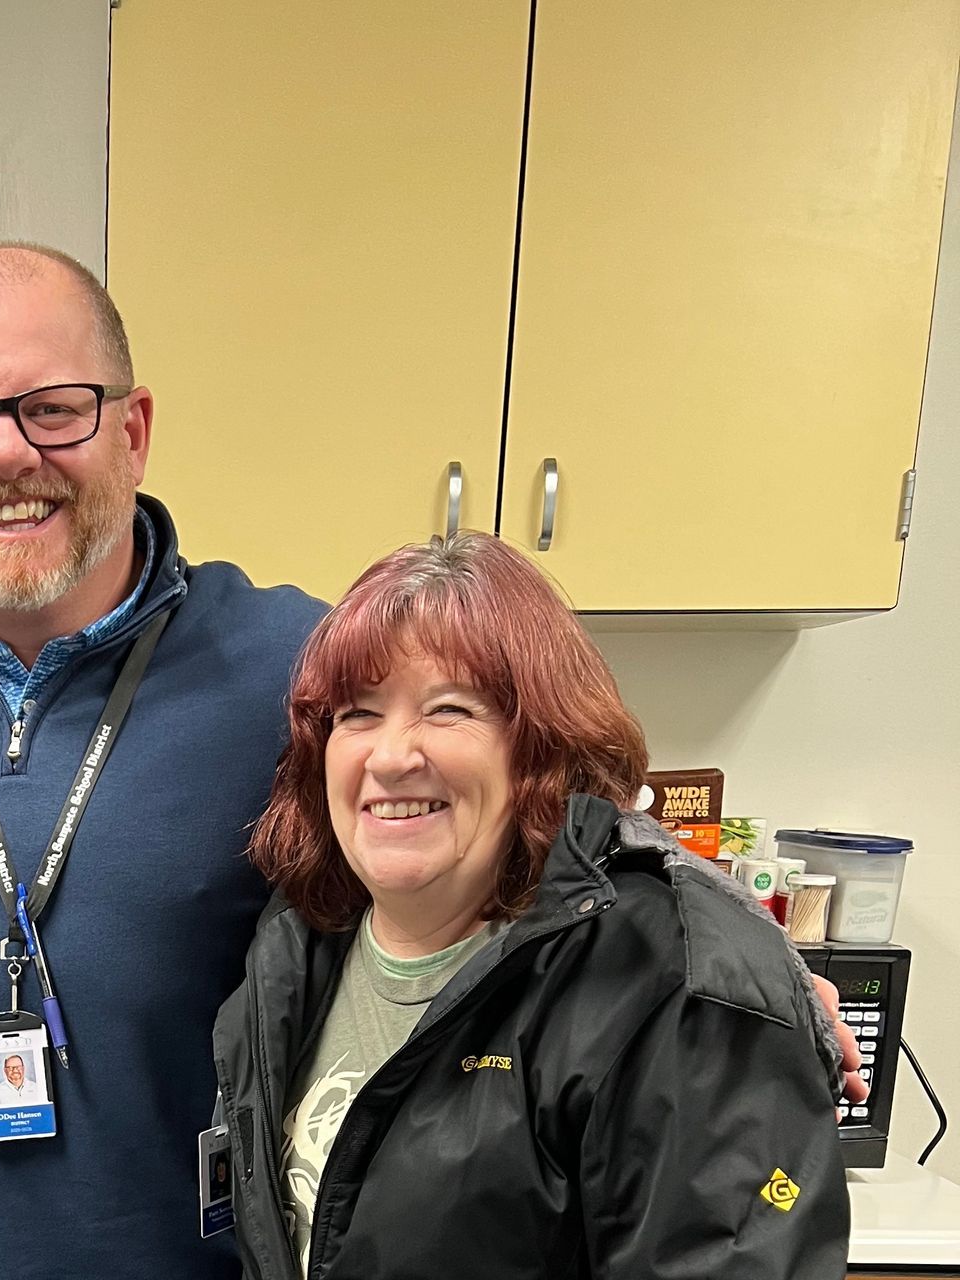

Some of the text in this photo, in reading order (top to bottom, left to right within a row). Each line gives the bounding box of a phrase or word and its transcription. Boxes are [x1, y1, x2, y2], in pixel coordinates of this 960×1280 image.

[663, 786, 710, 799] WIDE
[38, 724, 112, 886] North Sanpete School District
[662, 798, 710, 811] AWAKE
[661, 810, 694, 818] COFFEE
